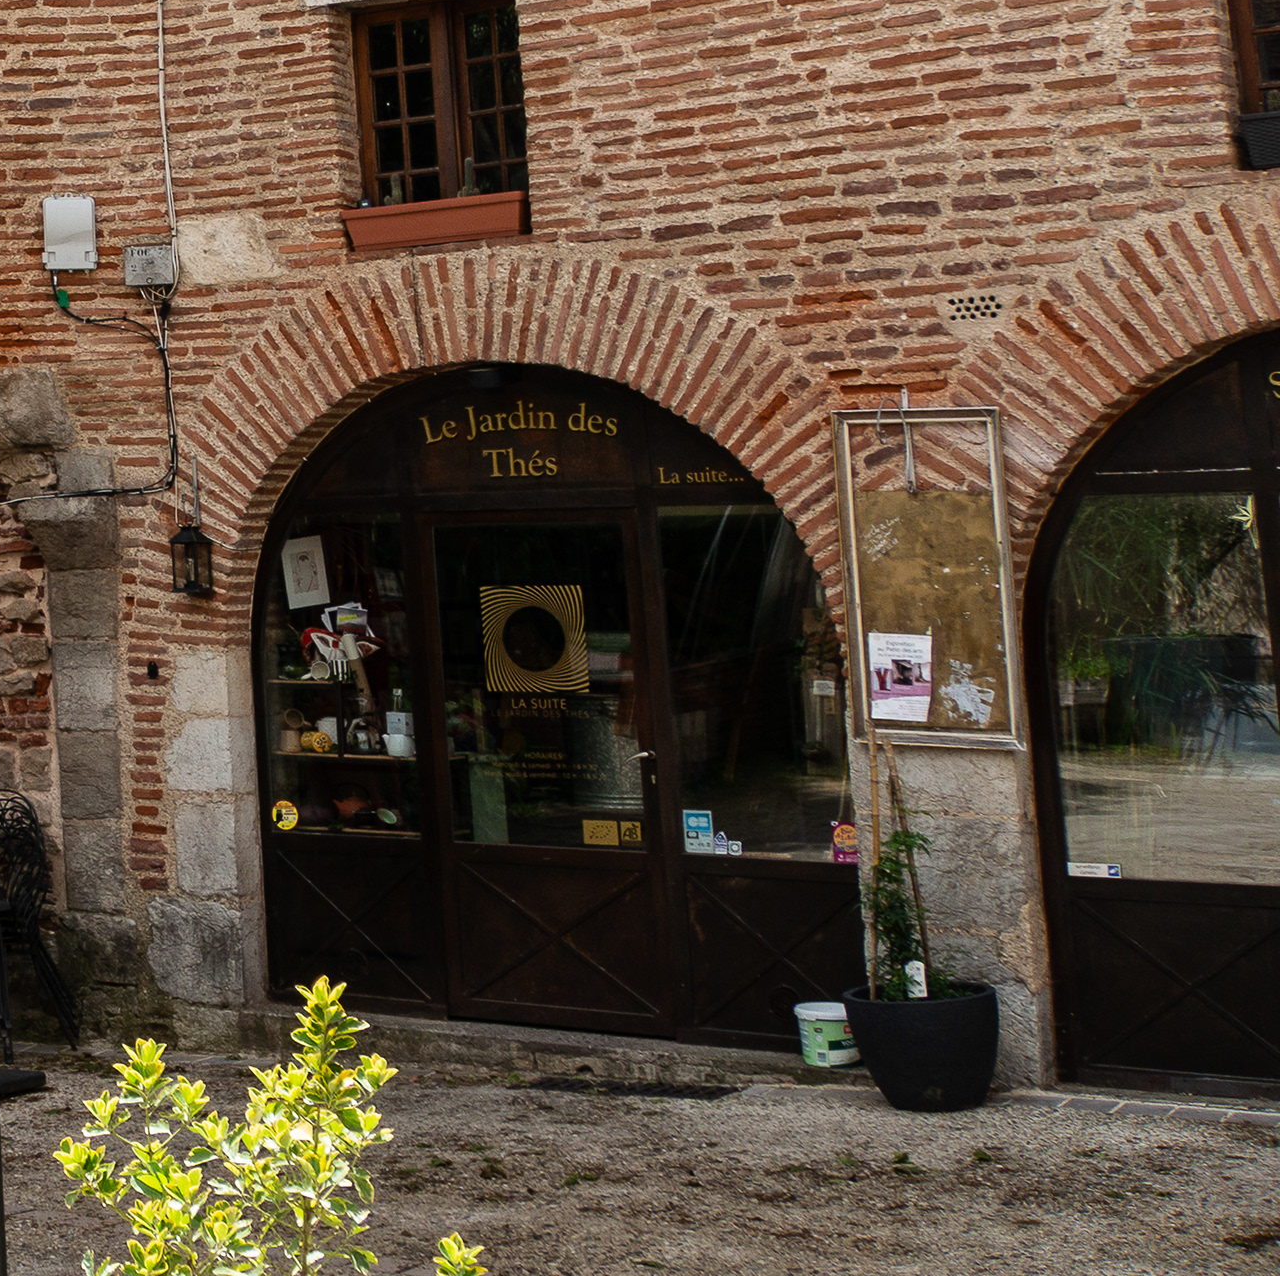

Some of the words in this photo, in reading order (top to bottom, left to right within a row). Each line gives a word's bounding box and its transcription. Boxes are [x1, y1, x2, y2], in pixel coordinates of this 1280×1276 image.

[419, 415, 458, 444] Le
[465, 400, 557, 441] Jardin
[567, 403, 618, 437] des
[482, 448, 558, 477] Thés
[657, 466, 680, 485] La
[511, 698, 527, 709] LA
[531, 698, 567, 710] SUITE
[504, 709, 539, 719] JARDIN
[542, 710, 561, 718] DES
